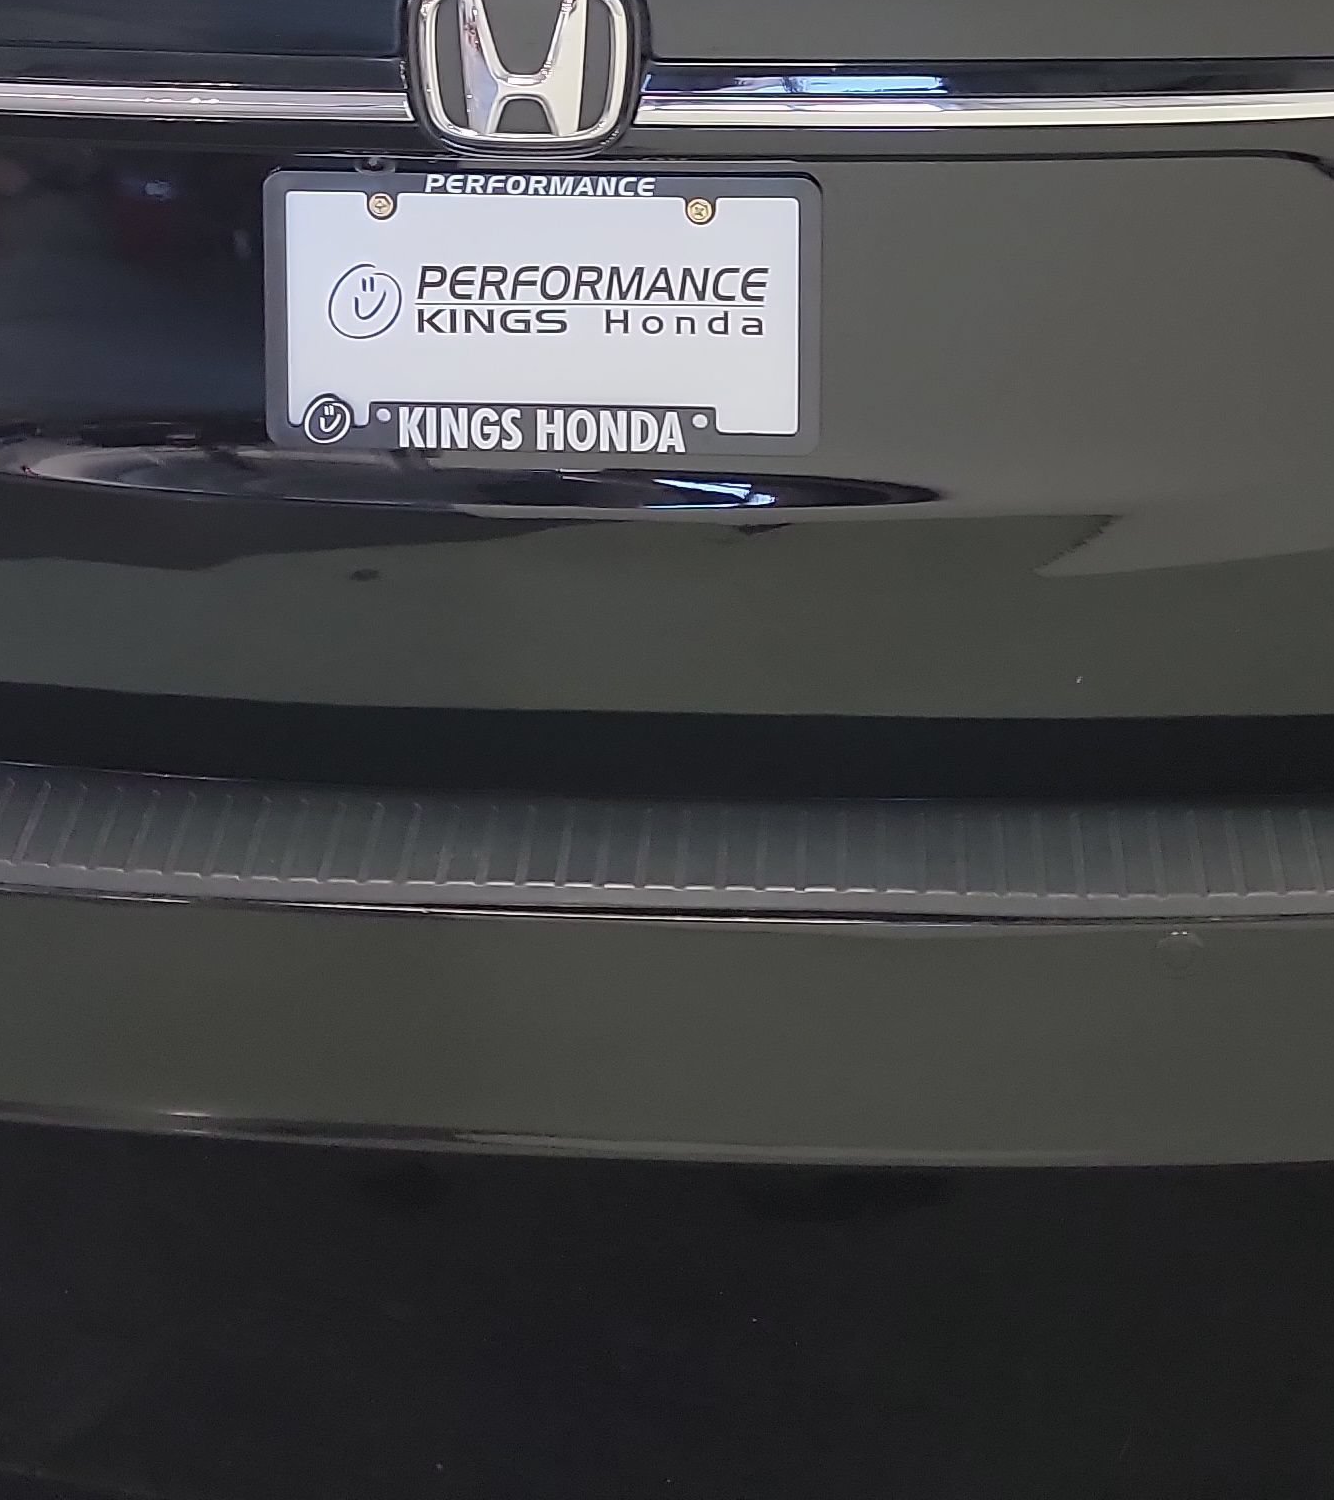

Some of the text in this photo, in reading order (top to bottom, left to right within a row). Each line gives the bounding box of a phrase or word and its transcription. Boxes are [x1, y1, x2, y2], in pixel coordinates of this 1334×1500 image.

[424, 174, 656, 197] PERFORMANCE
[416, 265, 770, 302] PERFORMANCE
[415, 310, 765, 335] KINGS Honda
[399, 406, 686, 453] KINGS HONDA
